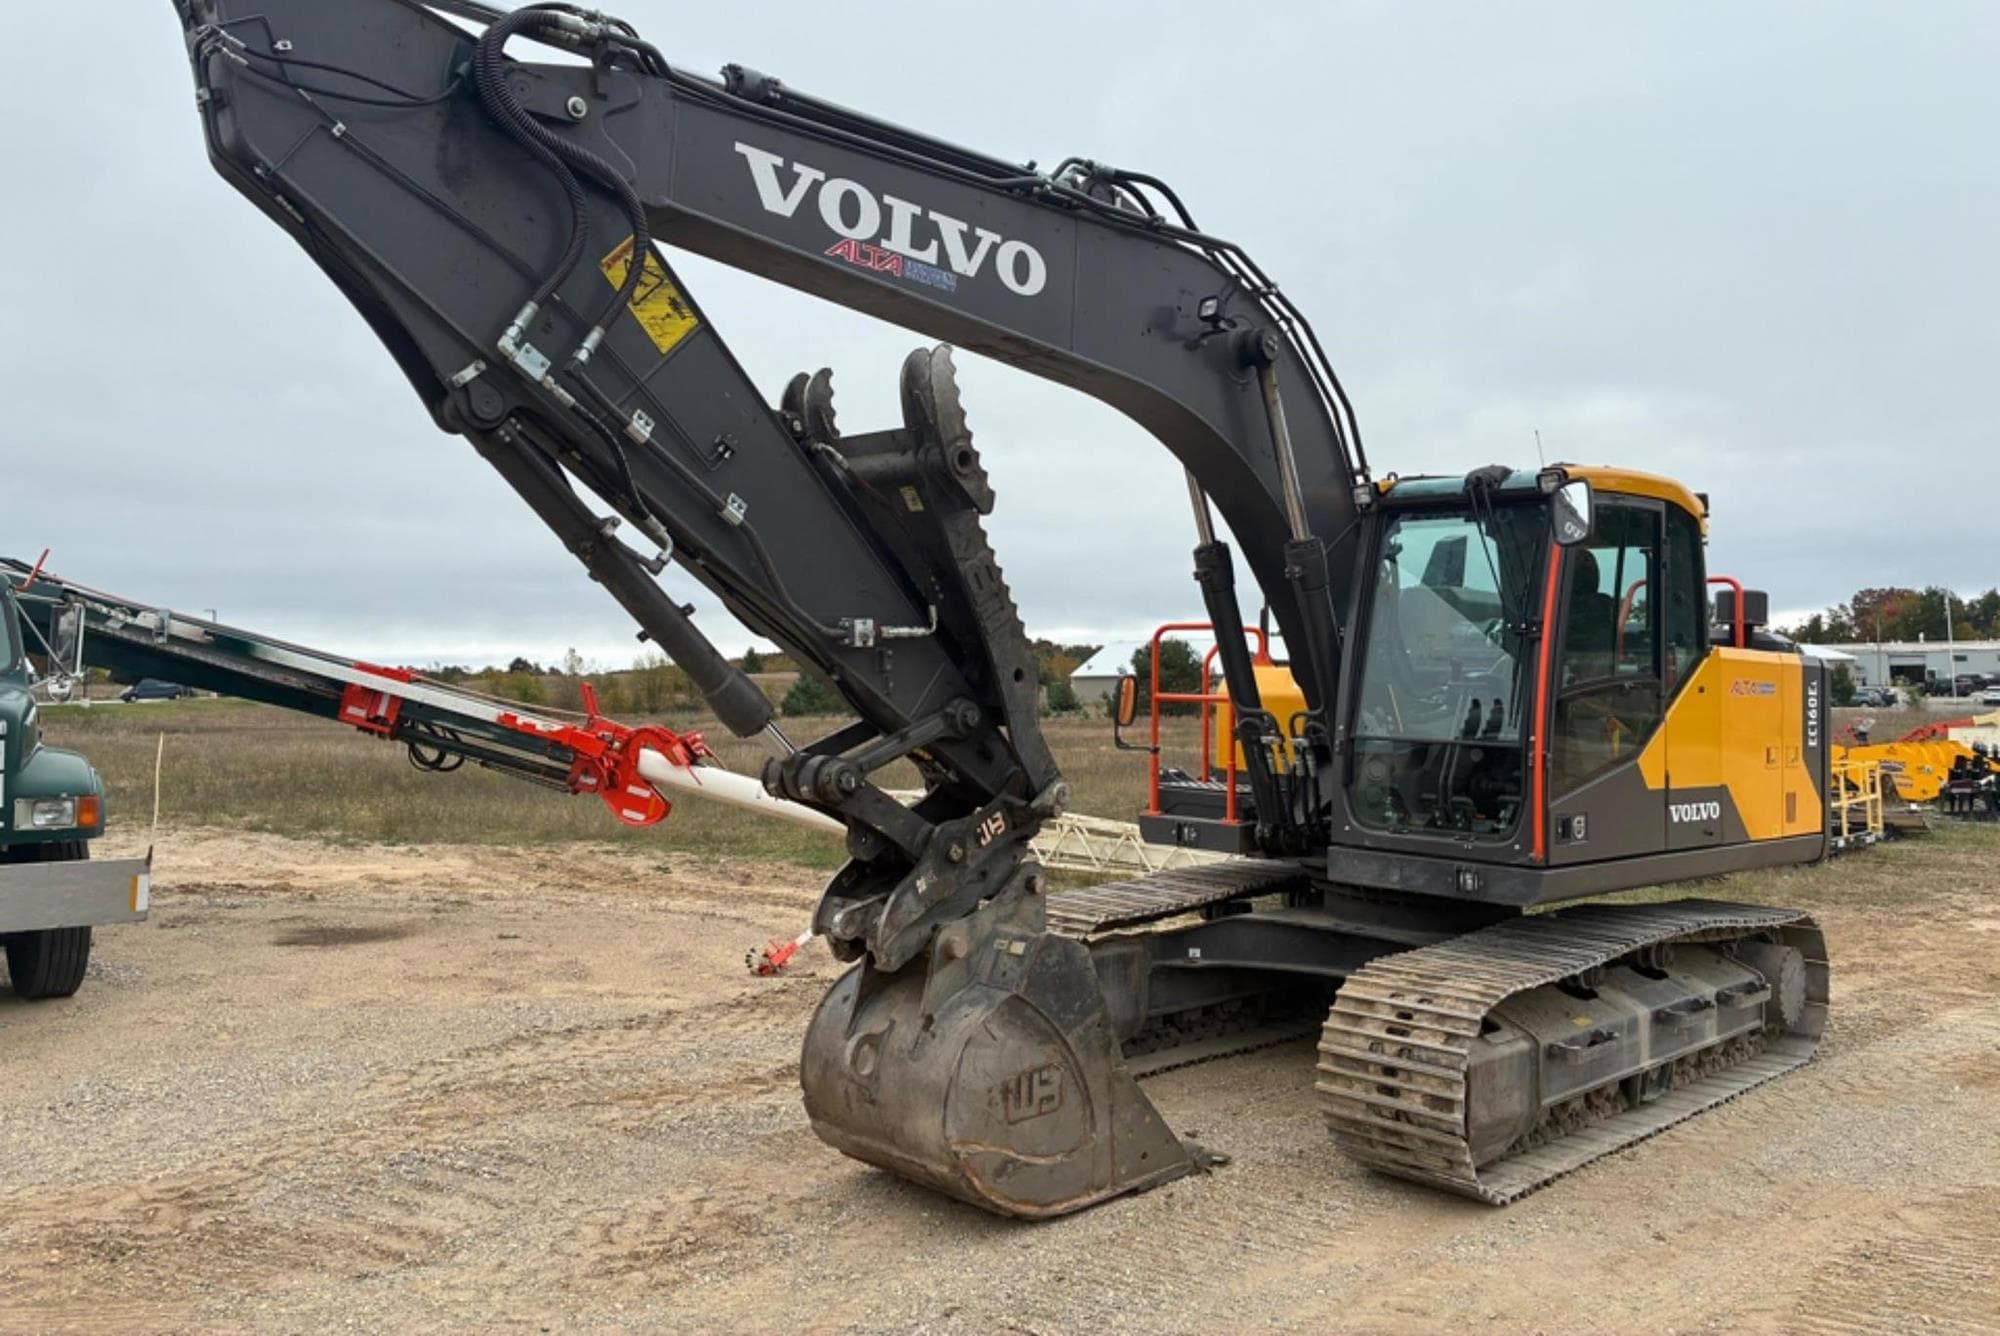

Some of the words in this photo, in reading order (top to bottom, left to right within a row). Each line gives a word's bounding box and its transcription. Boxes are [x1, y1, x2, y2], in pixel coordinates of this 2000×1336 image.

[735, 141, 1047, 296] VOLVO
[824, 239, 903, 277] ALTA
[1669, 801, 1720, 823] VOLVO
